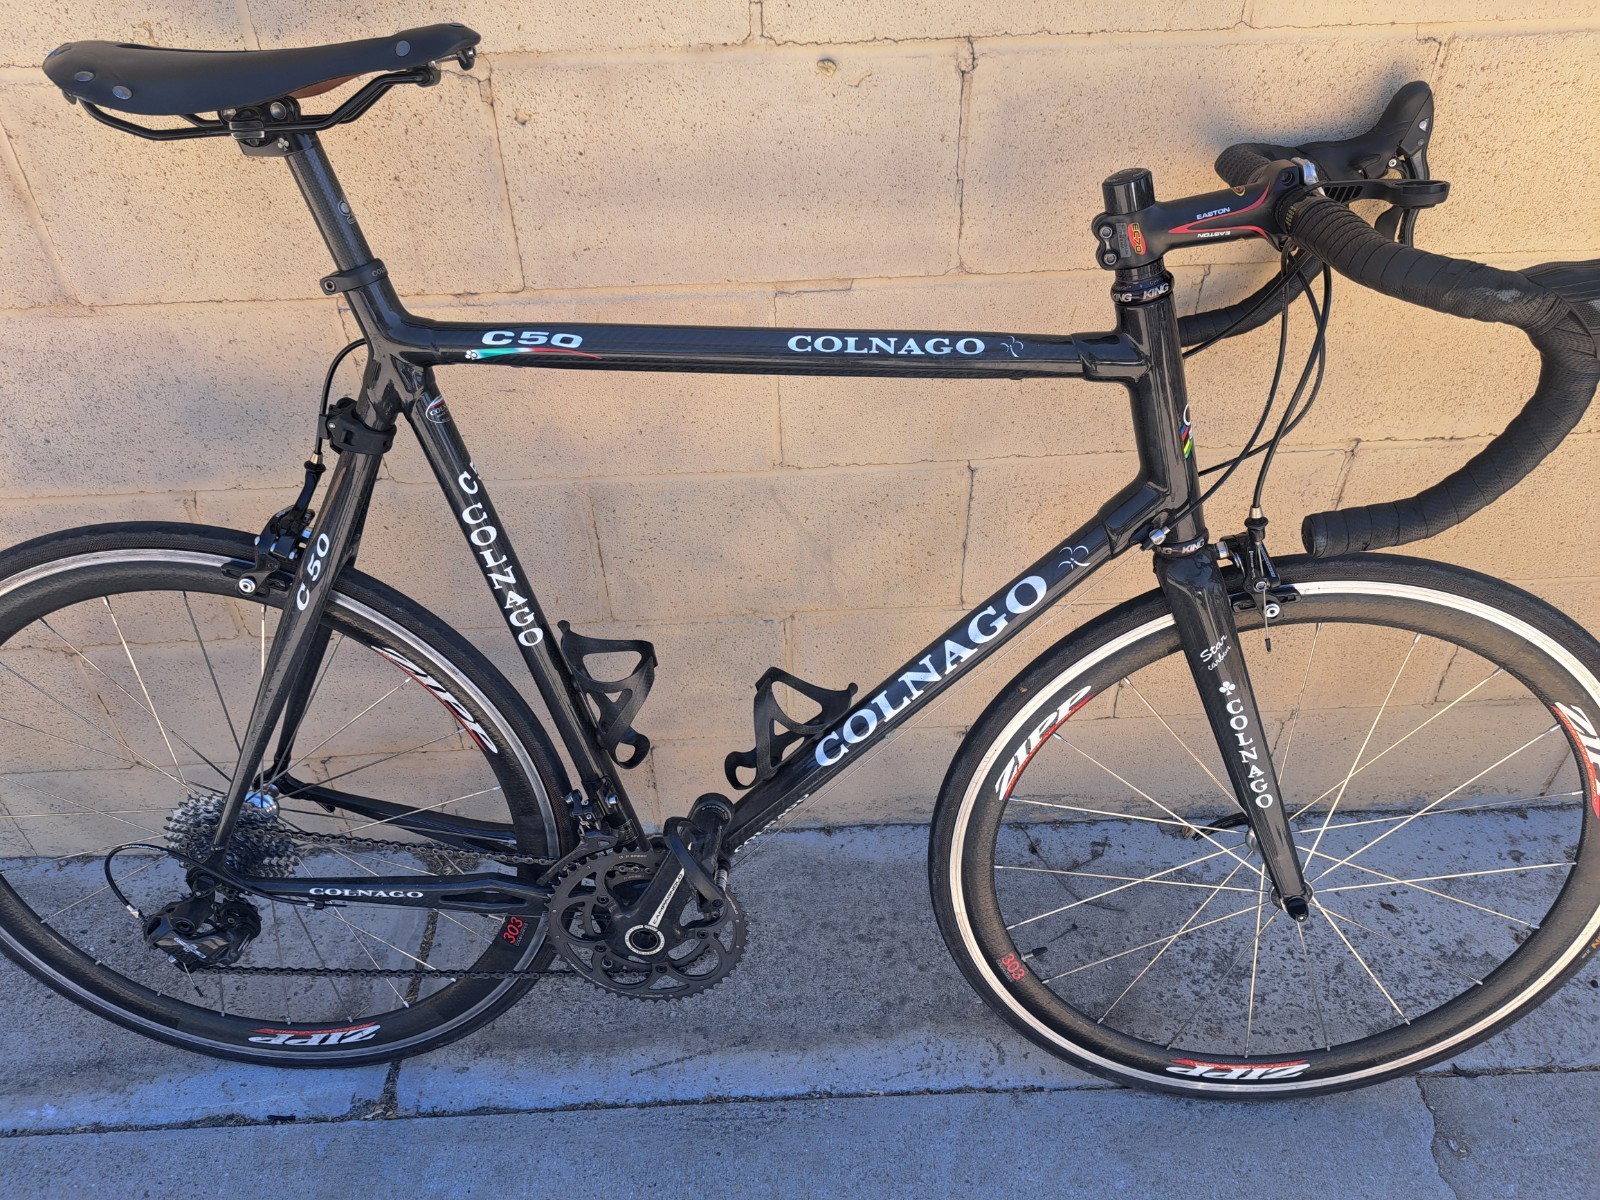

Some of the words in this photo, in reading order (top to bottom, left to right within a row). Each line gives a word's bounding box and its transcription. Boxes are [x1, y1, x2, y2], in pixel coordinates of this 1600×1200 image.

[1196, 207, 1231, 220] EASTON
[1131, 222, 1145, 254] EC70
[1197, 231, 1231, 239] EASTON
[1142, 282, 1169, 300] KING
[787, 335, 986, 355] COLNAGO
[1181, 538, 1205, 554] KING
[462, 502, 544, 647] COLNAGO
[1200, 634, 1228, 663] Star
[1207, 645, 1231, 671] carbon
[815, 575, 1047, 767] COLNAGO
[994, 685, 1092, 801] ZIPP
[1226, 698, 1274, 809] COLNAGO
[308, 887, 424, 898] COLNAGO
[652, 873, 684, 926] CAMPAGNOLO
[503, 916, 523, 945] 303
[1001, 953, 1025, 981] 303
[248, 1024, 381, 1046] ZIPP
[1165, 1063, 1311, 1080] ZIPP
